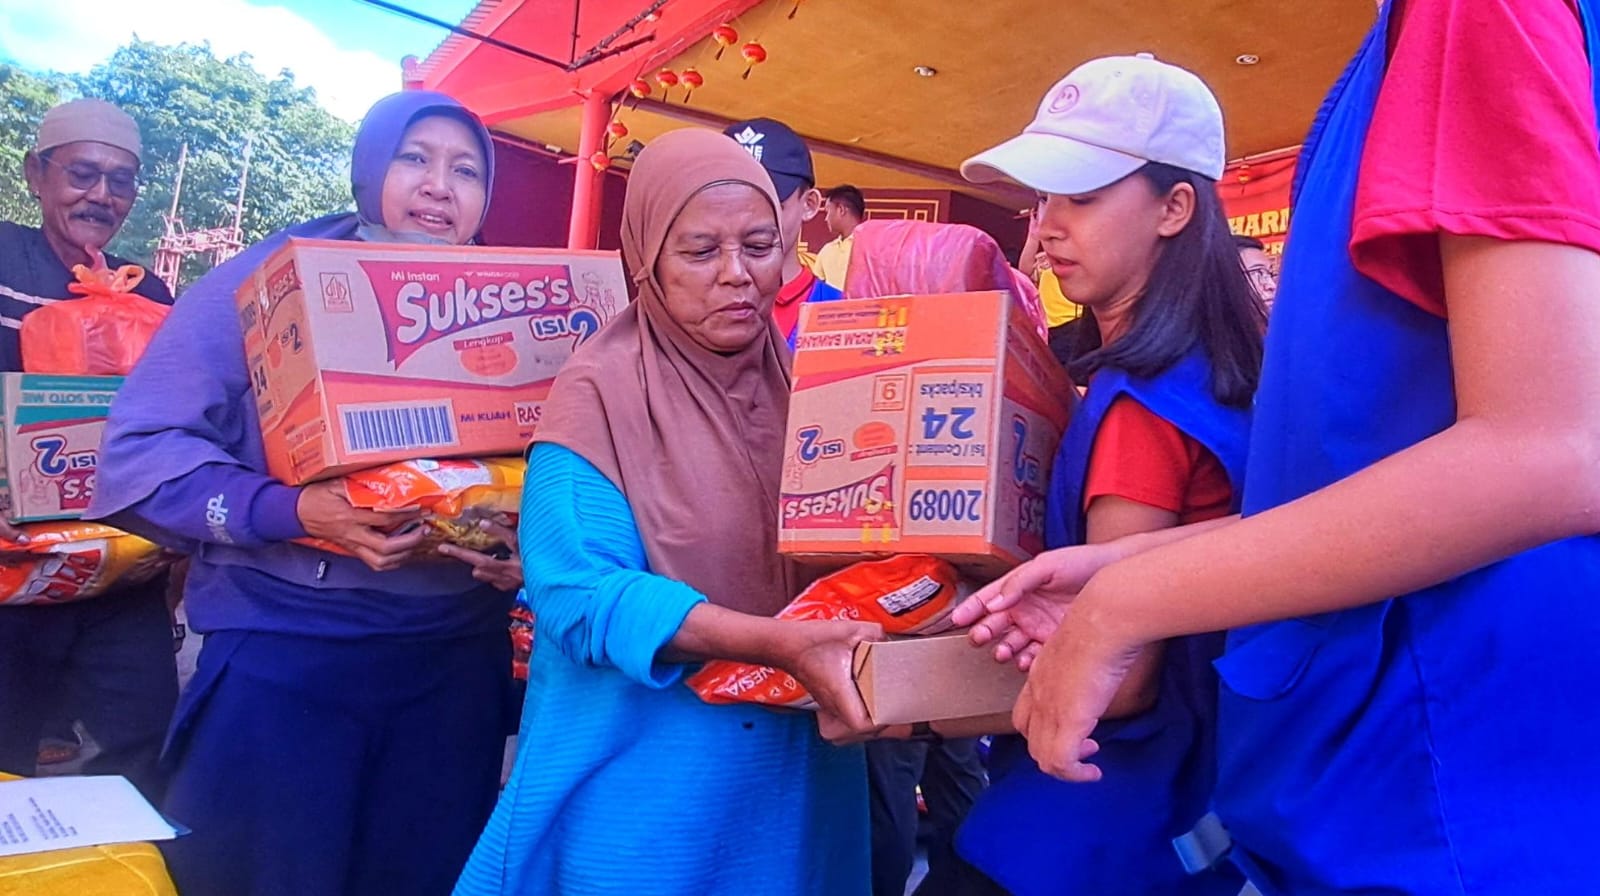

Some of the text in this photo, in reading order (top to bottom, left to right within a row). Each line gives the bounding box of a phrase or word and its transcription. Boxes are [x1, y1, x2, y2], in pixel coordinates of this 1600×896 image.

[407, 271, 440, 282] Instan
[396, 277, 570, 344] Sukses's
[534, 317, 567, 336] ISI
[844, 331, 874, 347] AYAM
[49, 393, 85, 405] SOTO
[477, 411, 511, 422] KUAH
[922, 406, 977, 440] 24
[799, 428, 820, 461] 2
[823, 443, 842, 455] ISI
[35, 439, 96, 475] ISI 2
[910, 489, 982, 522] 20089
